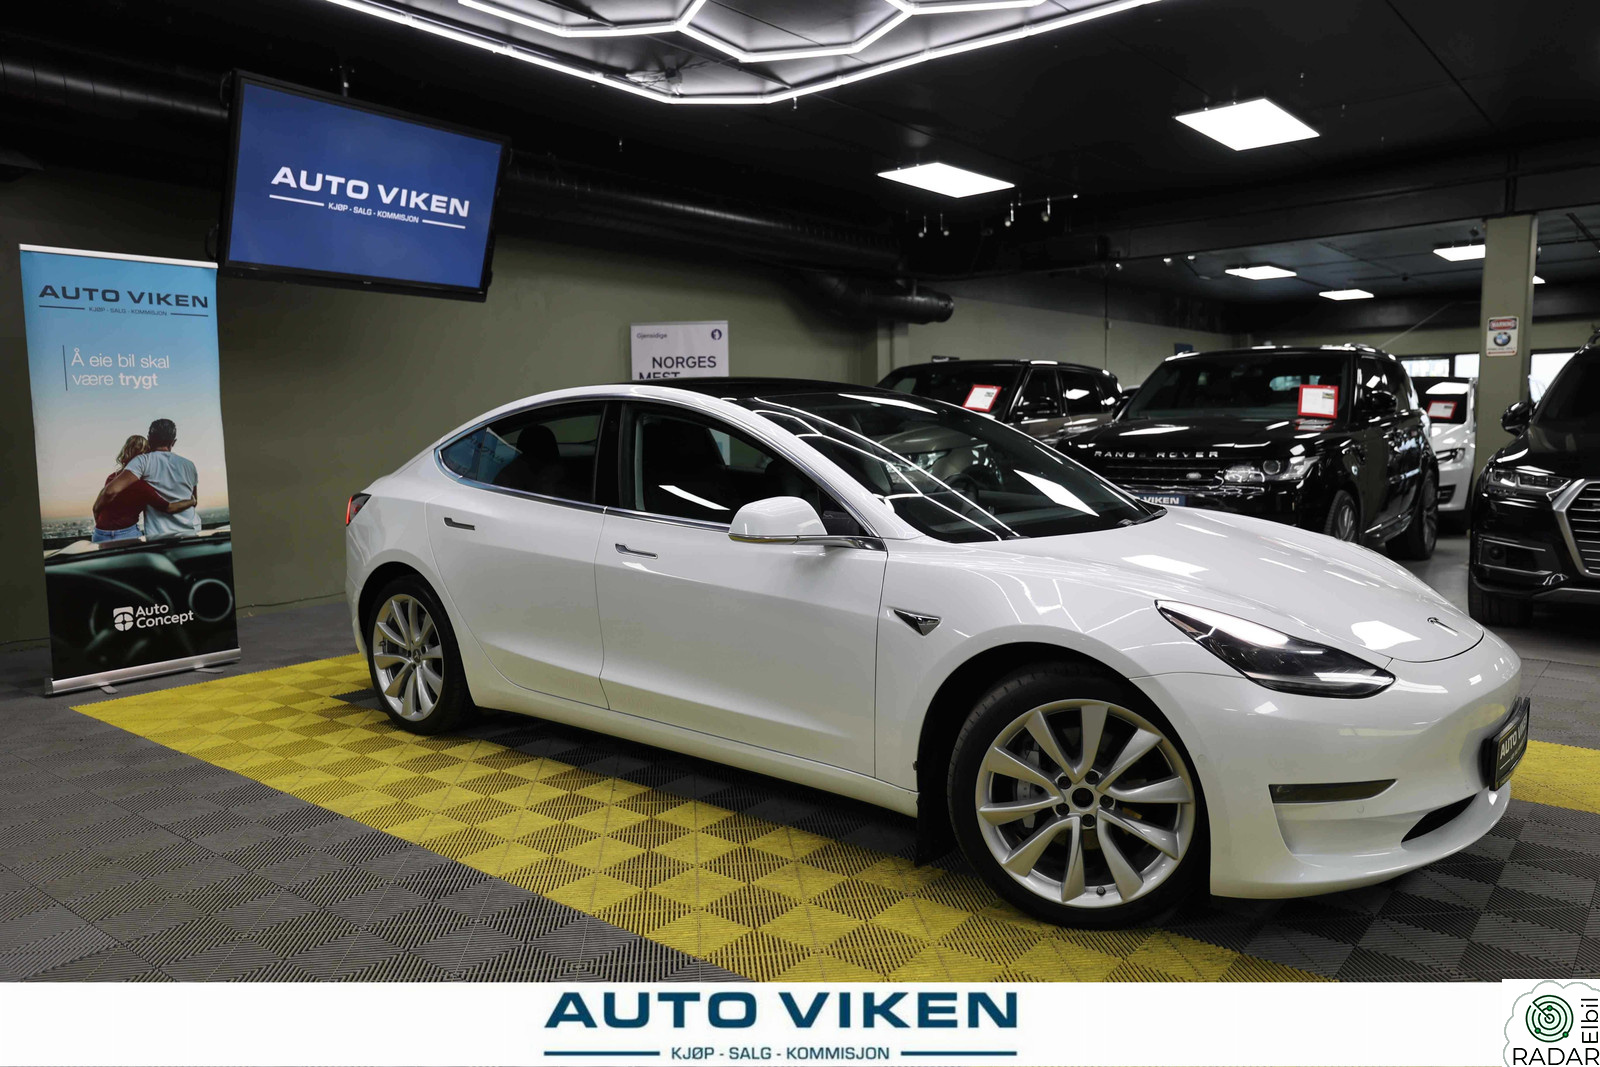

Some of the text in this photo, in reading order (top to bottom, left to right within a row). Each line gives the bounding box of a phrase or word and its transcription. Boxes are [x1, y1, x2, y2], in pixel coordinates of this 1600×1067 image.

[271, 166, 470, 217] AUTO VIKEN
[328, 202, 349, 212] KJØP
[353, 206, 373, 216] SALG
[377, 209, 420, 223] KOMMISJON
[39, 285, 209, 308] AUTO VIKEN
[636, 332, 668, 340] Gjensidige
[71, 348, 170, 369] Å eie bil skal
[652, 355, 717, 369] NORGES
[72, 372, 159, 389] være trygt
[1094, 450, 1146, 458] RANG
[1143, 496, 1180, 504] VIKEN
[135, 603, 169, 618] Auto
[136, 610, 194, 629] Concept
[1500, 730, 1518, 760] AUTO
